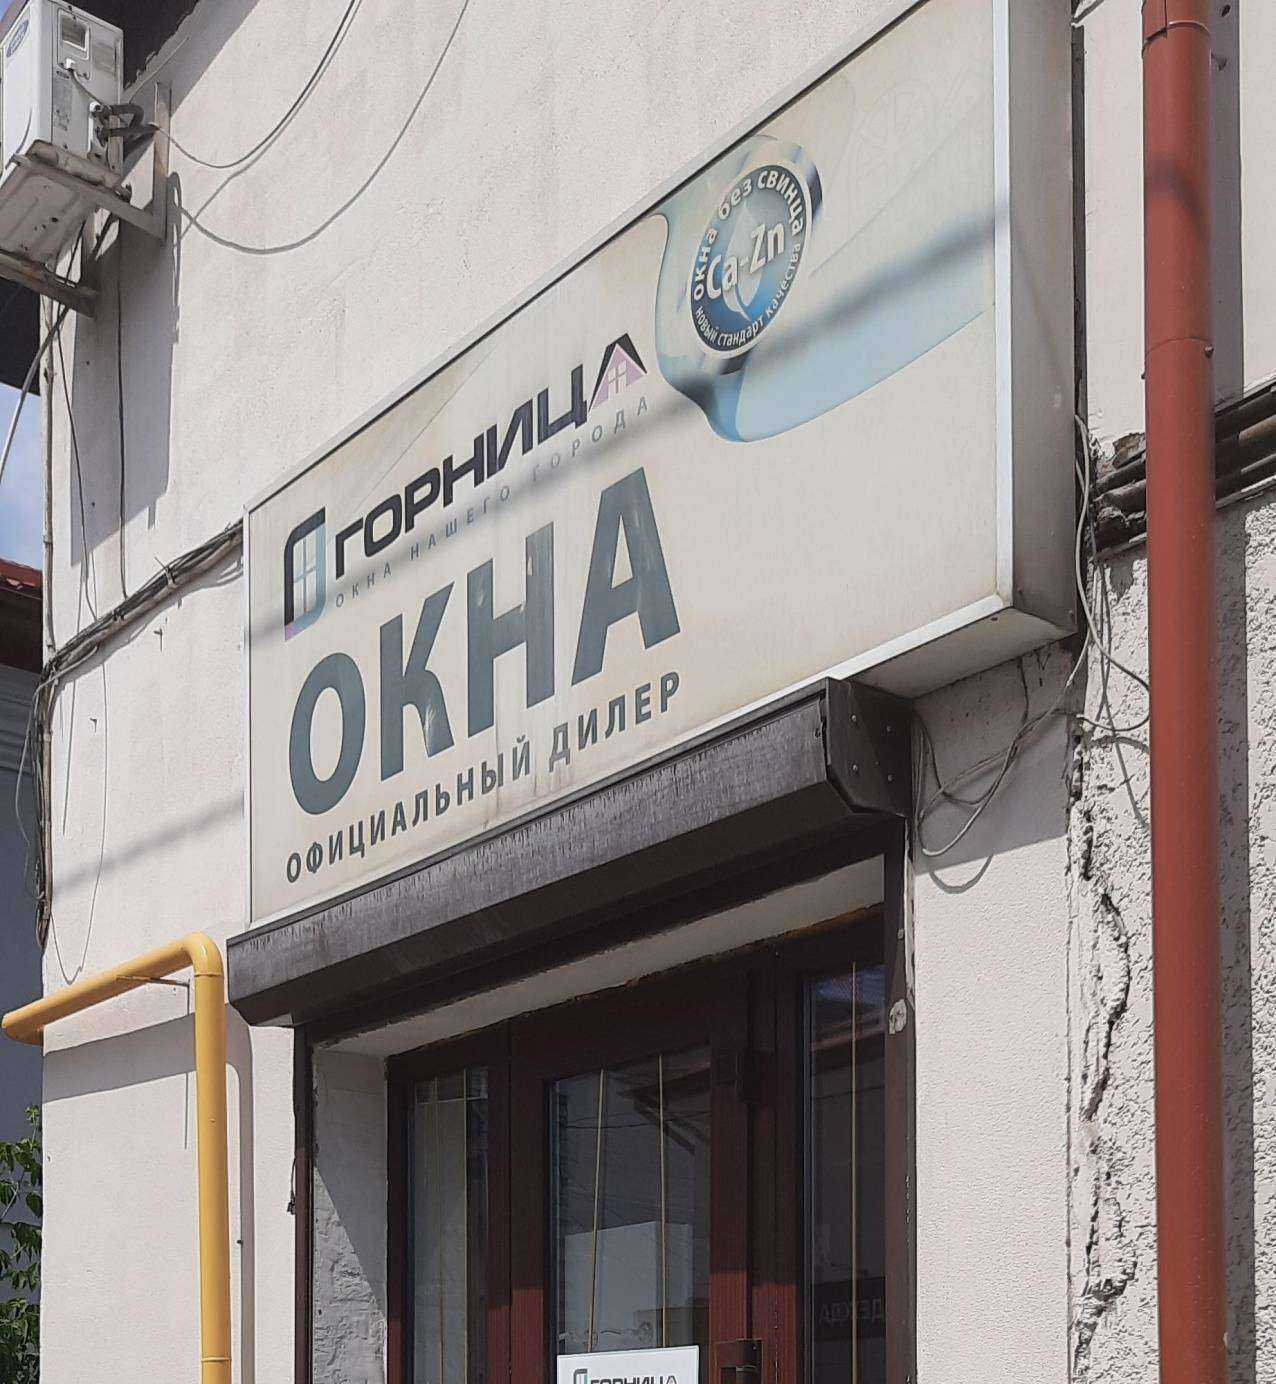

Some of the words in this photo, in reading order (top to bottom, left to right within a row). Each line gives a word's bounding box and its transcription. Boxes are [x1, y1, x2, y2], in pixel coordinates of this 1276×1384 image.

[706, 221, 785, 300] Ca-Zn
[717, 319, 764, 347] стандарт
[765, 243, 801, 320] качества
[719, 178, 752, 221] без
[335, 332, 648, 580] ГОРНИЦА
[335, 563, 392, 608] ОКНА
[410, 485, 511, 561] НАШЕГО
[532, 396, 648, 482] ГОРОДА
[288, 466, 681, 815] ОКНА
[286, 735, 531, 883] ОФИЦИАЛЬНЫЙ
[548, 670, 681, 772] ДИЛЕР
